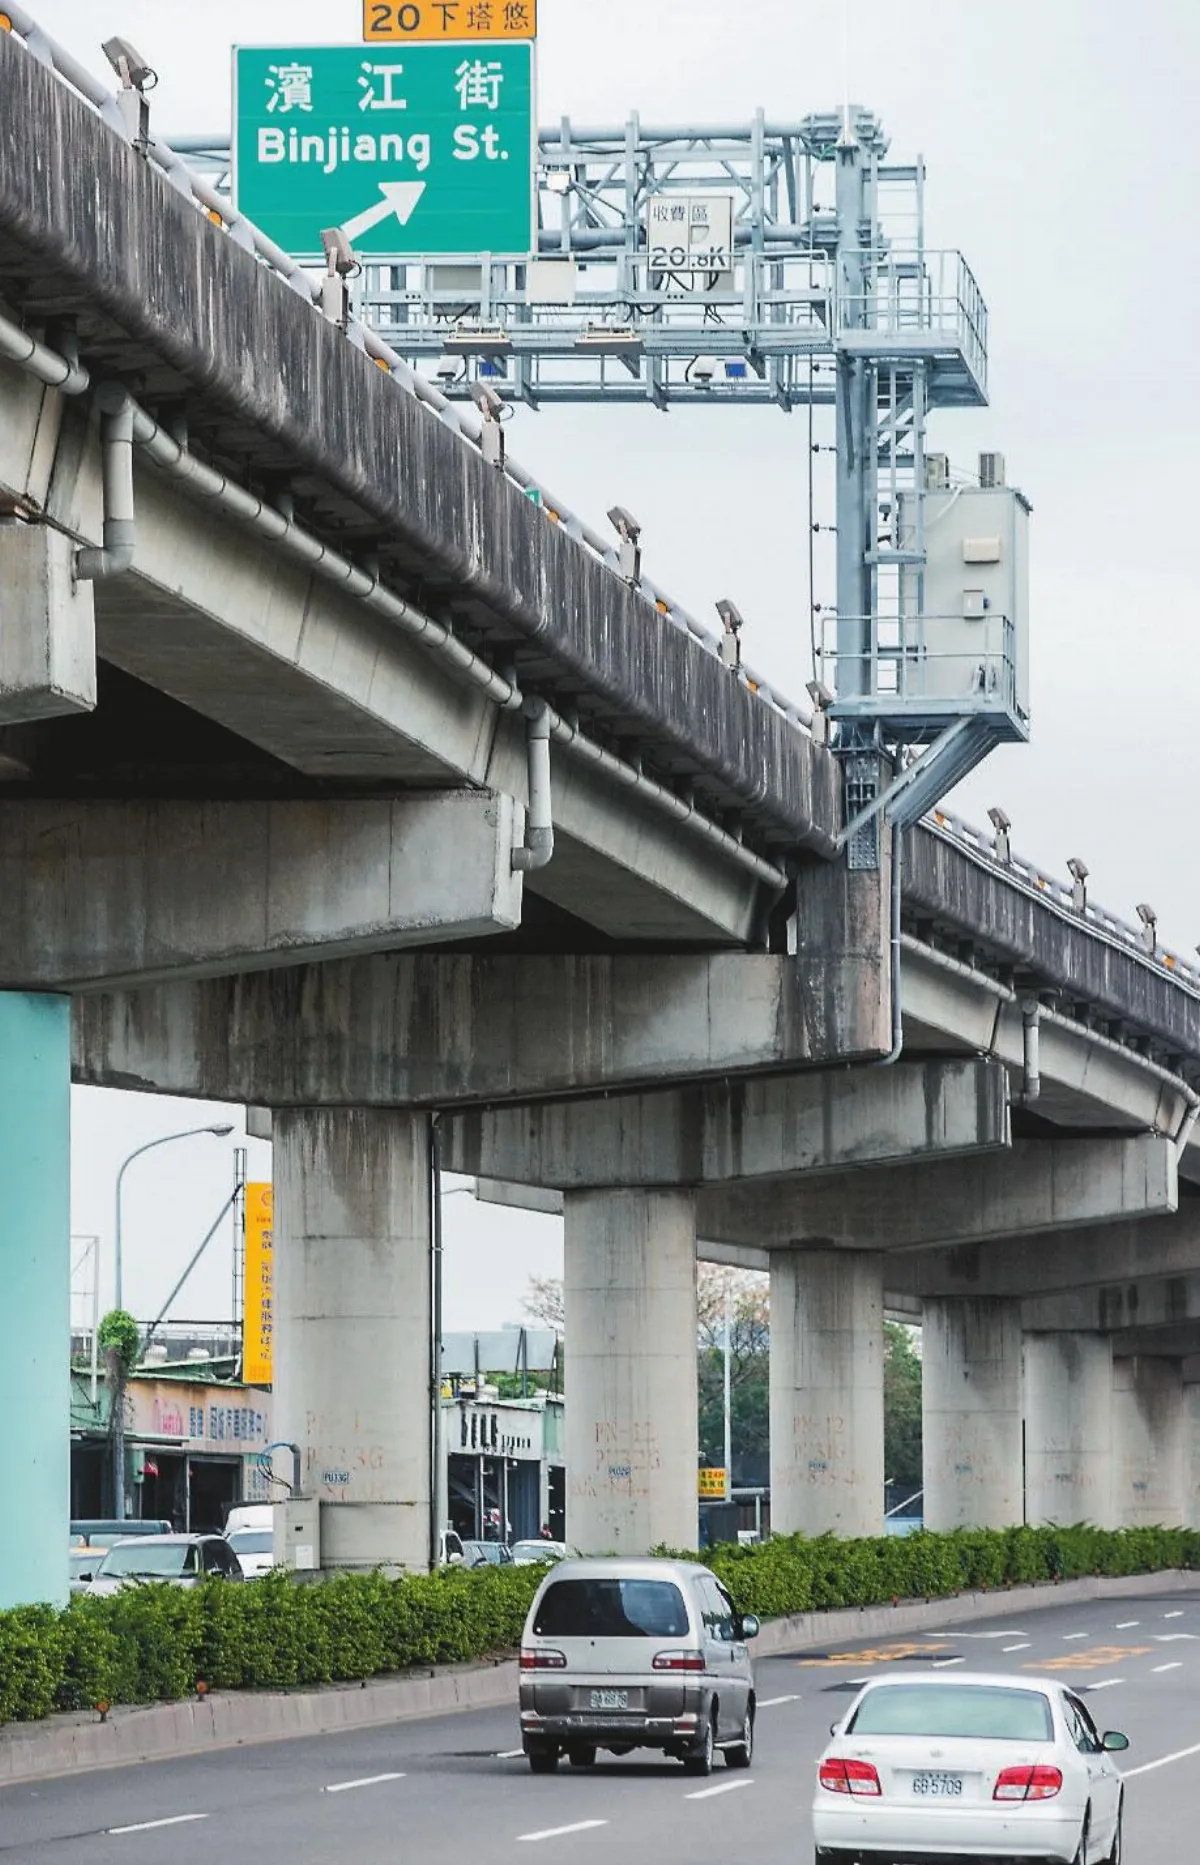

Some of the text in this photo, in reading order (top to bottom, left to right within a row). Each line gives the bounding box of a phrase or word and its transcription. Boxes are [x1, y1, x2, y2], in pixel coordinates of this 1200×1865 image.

[371, 4, 420, 32] 20
[264, 59, 504, 113] 濱江街
[257, 124, 509, 174] Binjiang St.
